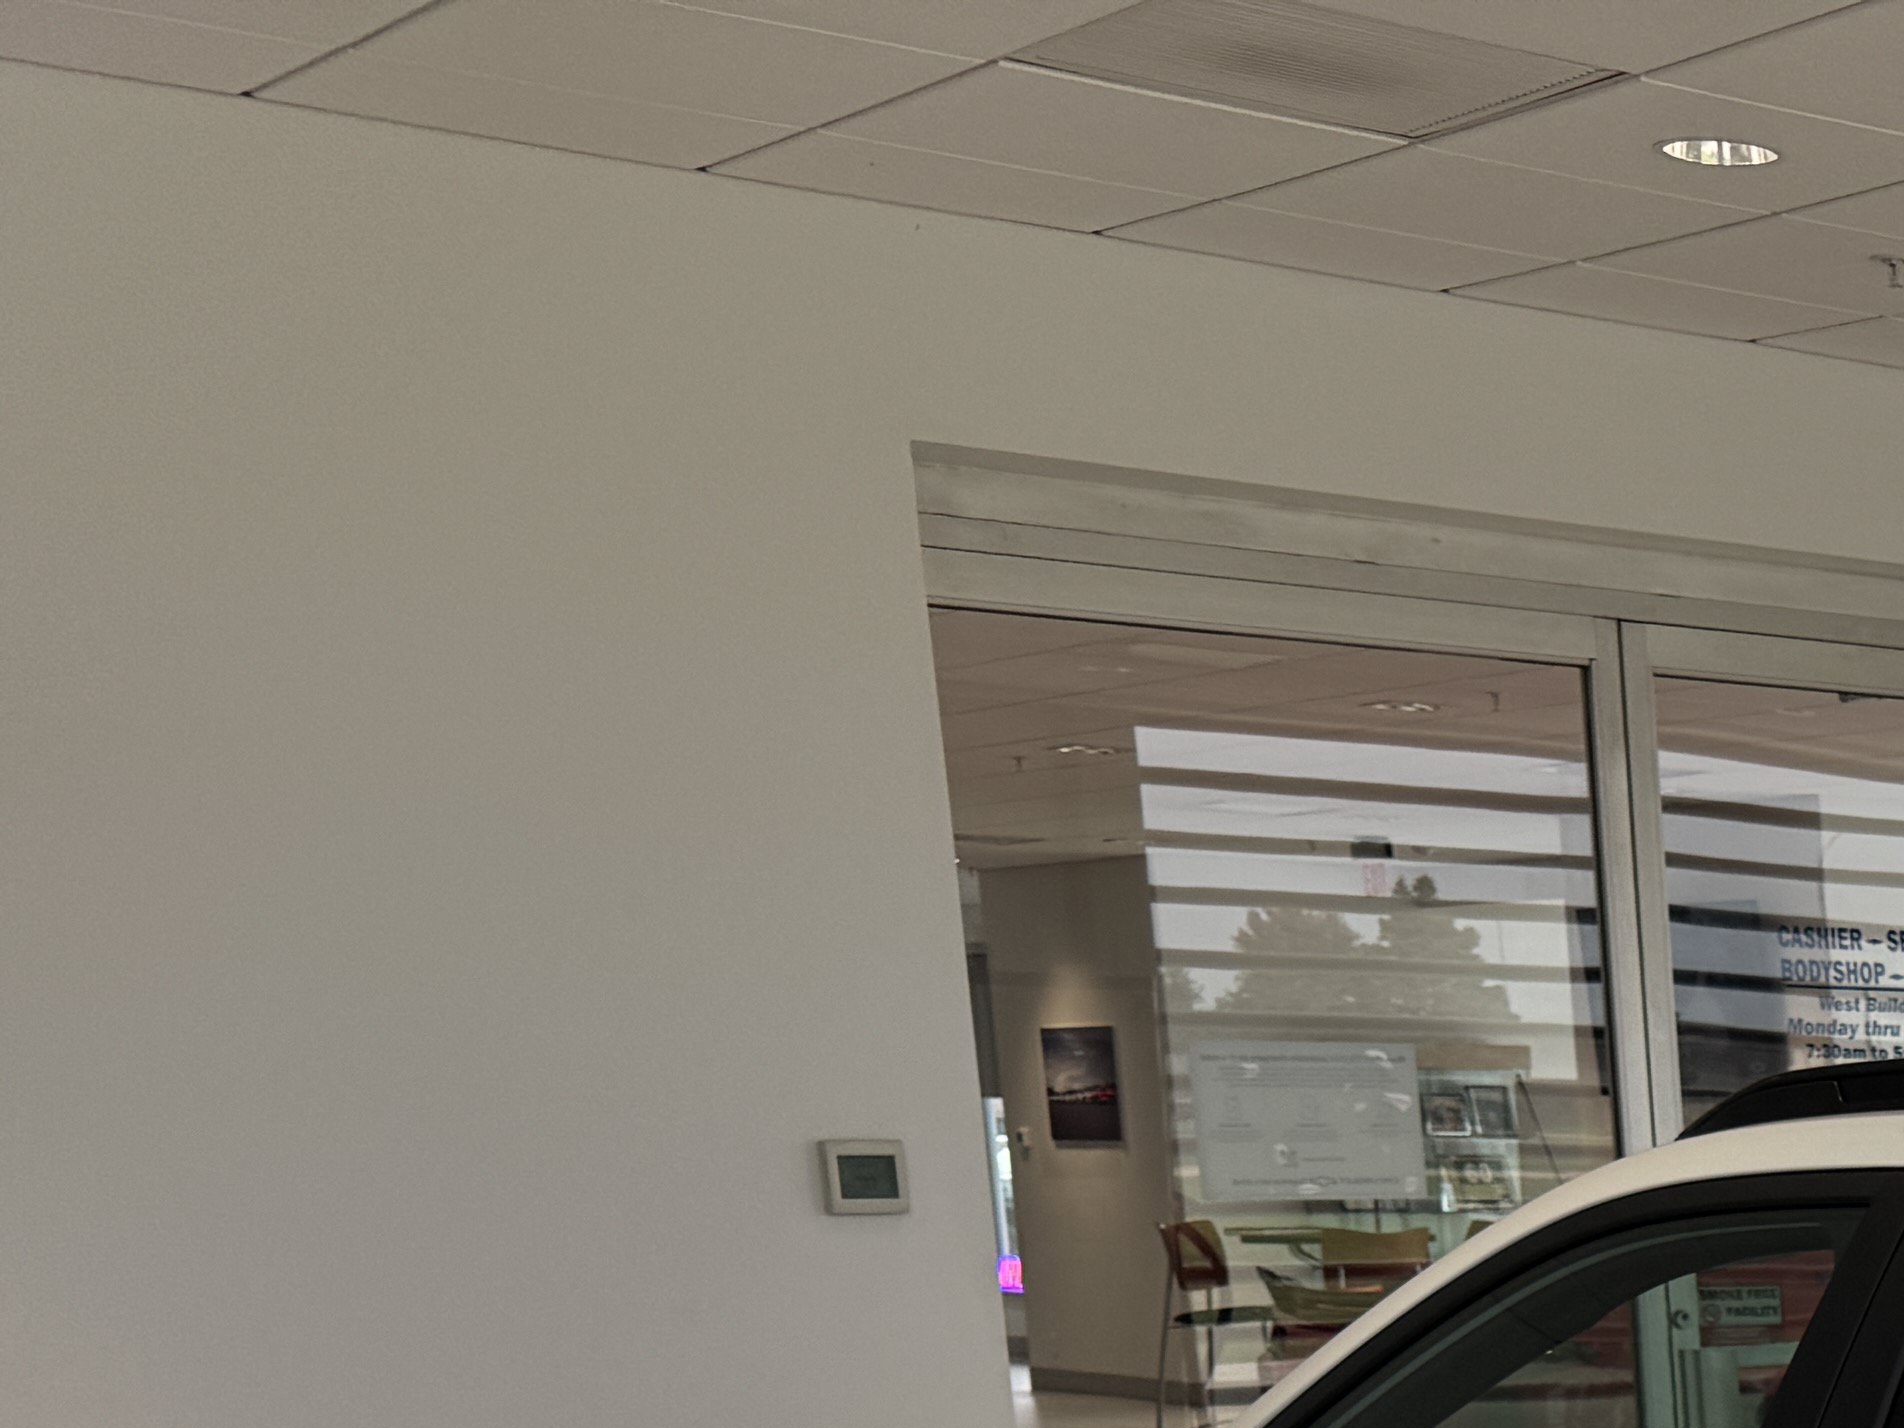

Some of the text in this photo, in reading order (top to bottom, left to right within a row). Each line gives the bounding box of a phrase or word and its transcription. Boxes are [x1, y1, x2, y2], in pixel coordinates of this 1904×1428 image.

[1777, 925, 1863, 950] CASHIER
[1780, 958, 1886, 984] BODYSHOP
[1818, 997, 1861, 1012] West
[1787, 1018, 1859, 1040] Monday
[1865, 1020, 1901, 1037] thru
[1805, 1044, 1867, 1059] 7:30am
[1872, 1046, 1888, 1060] to
